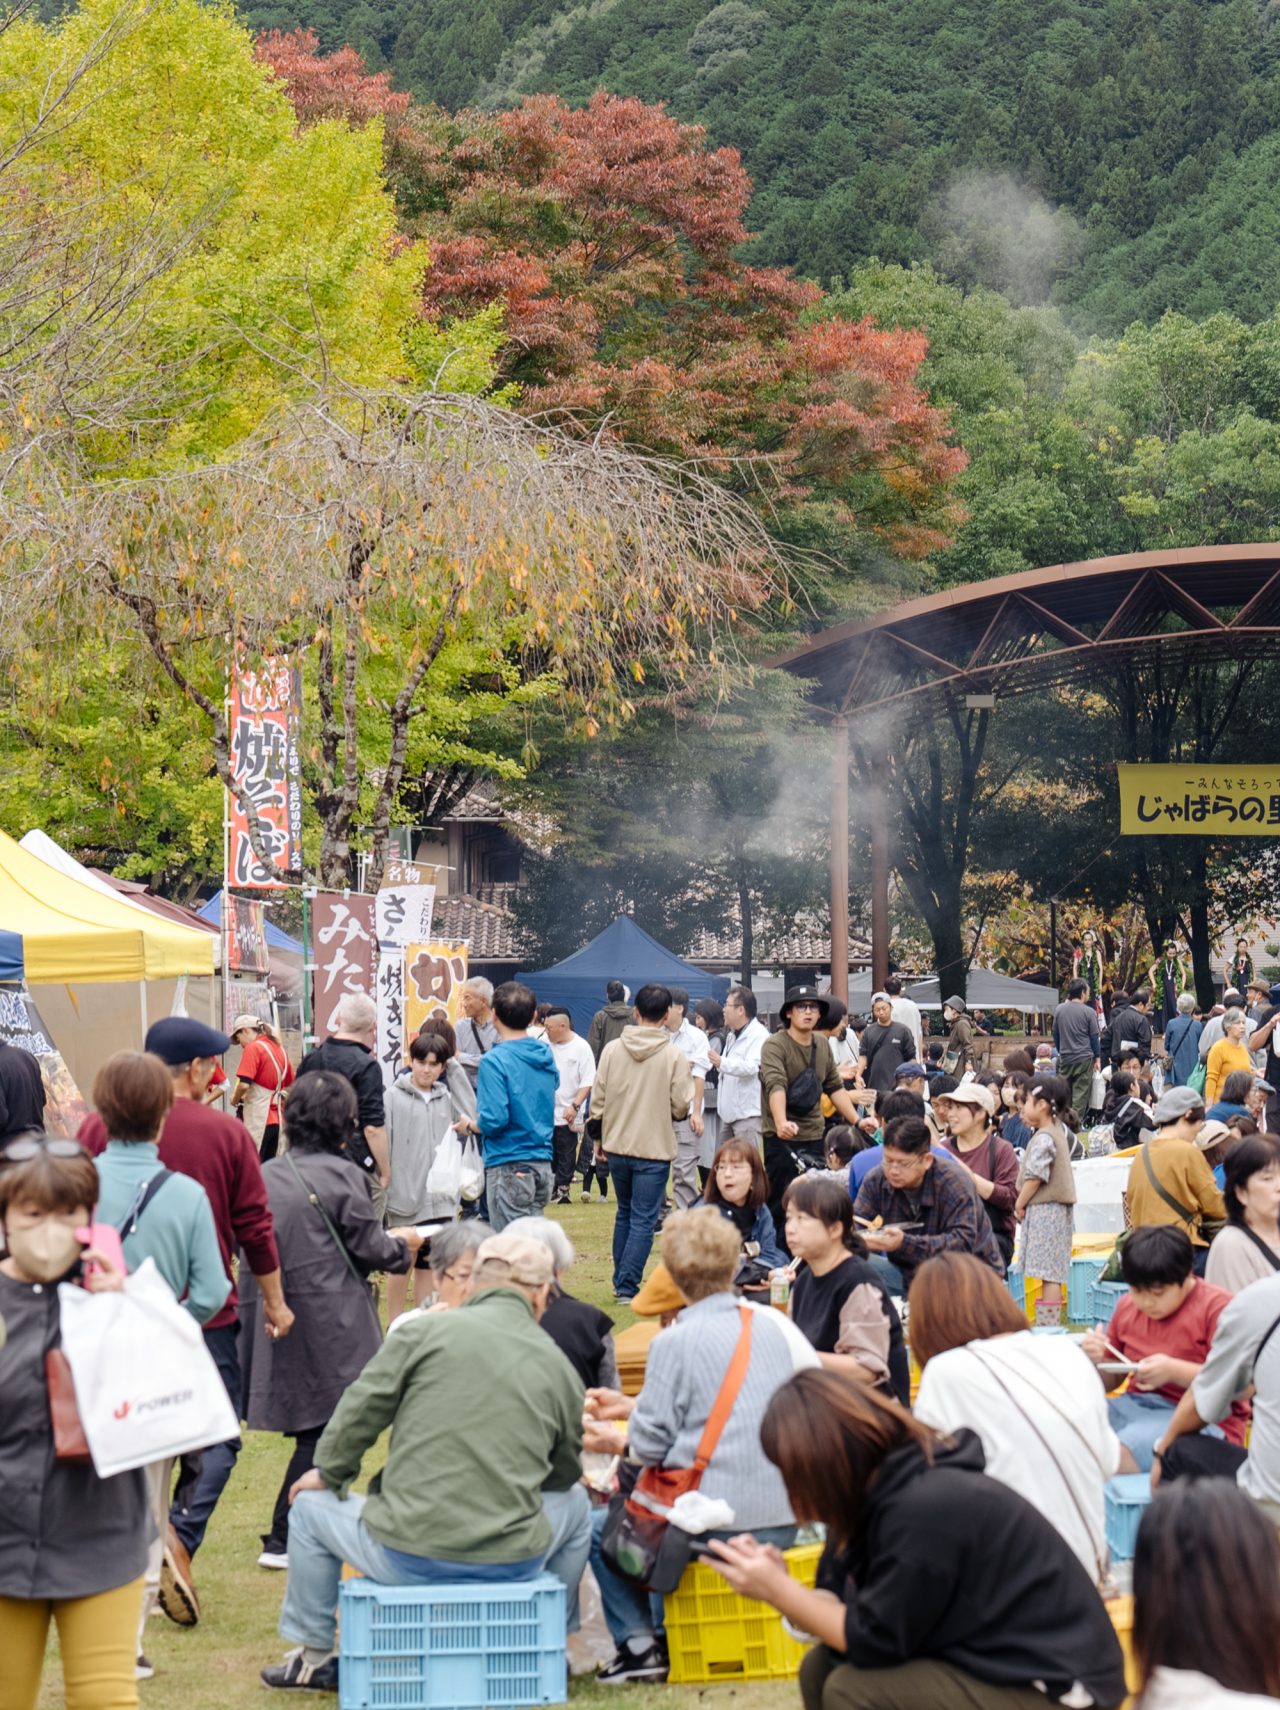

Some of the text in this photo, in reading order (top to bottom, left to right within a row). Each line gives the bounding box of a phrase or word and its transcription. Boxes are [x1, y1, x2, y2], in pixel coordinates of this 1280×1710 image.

[234, 717, 289, 885] 焼そば
[386, 866, 421, 884] 名物
[418, 897, 430, 944] こだわり
